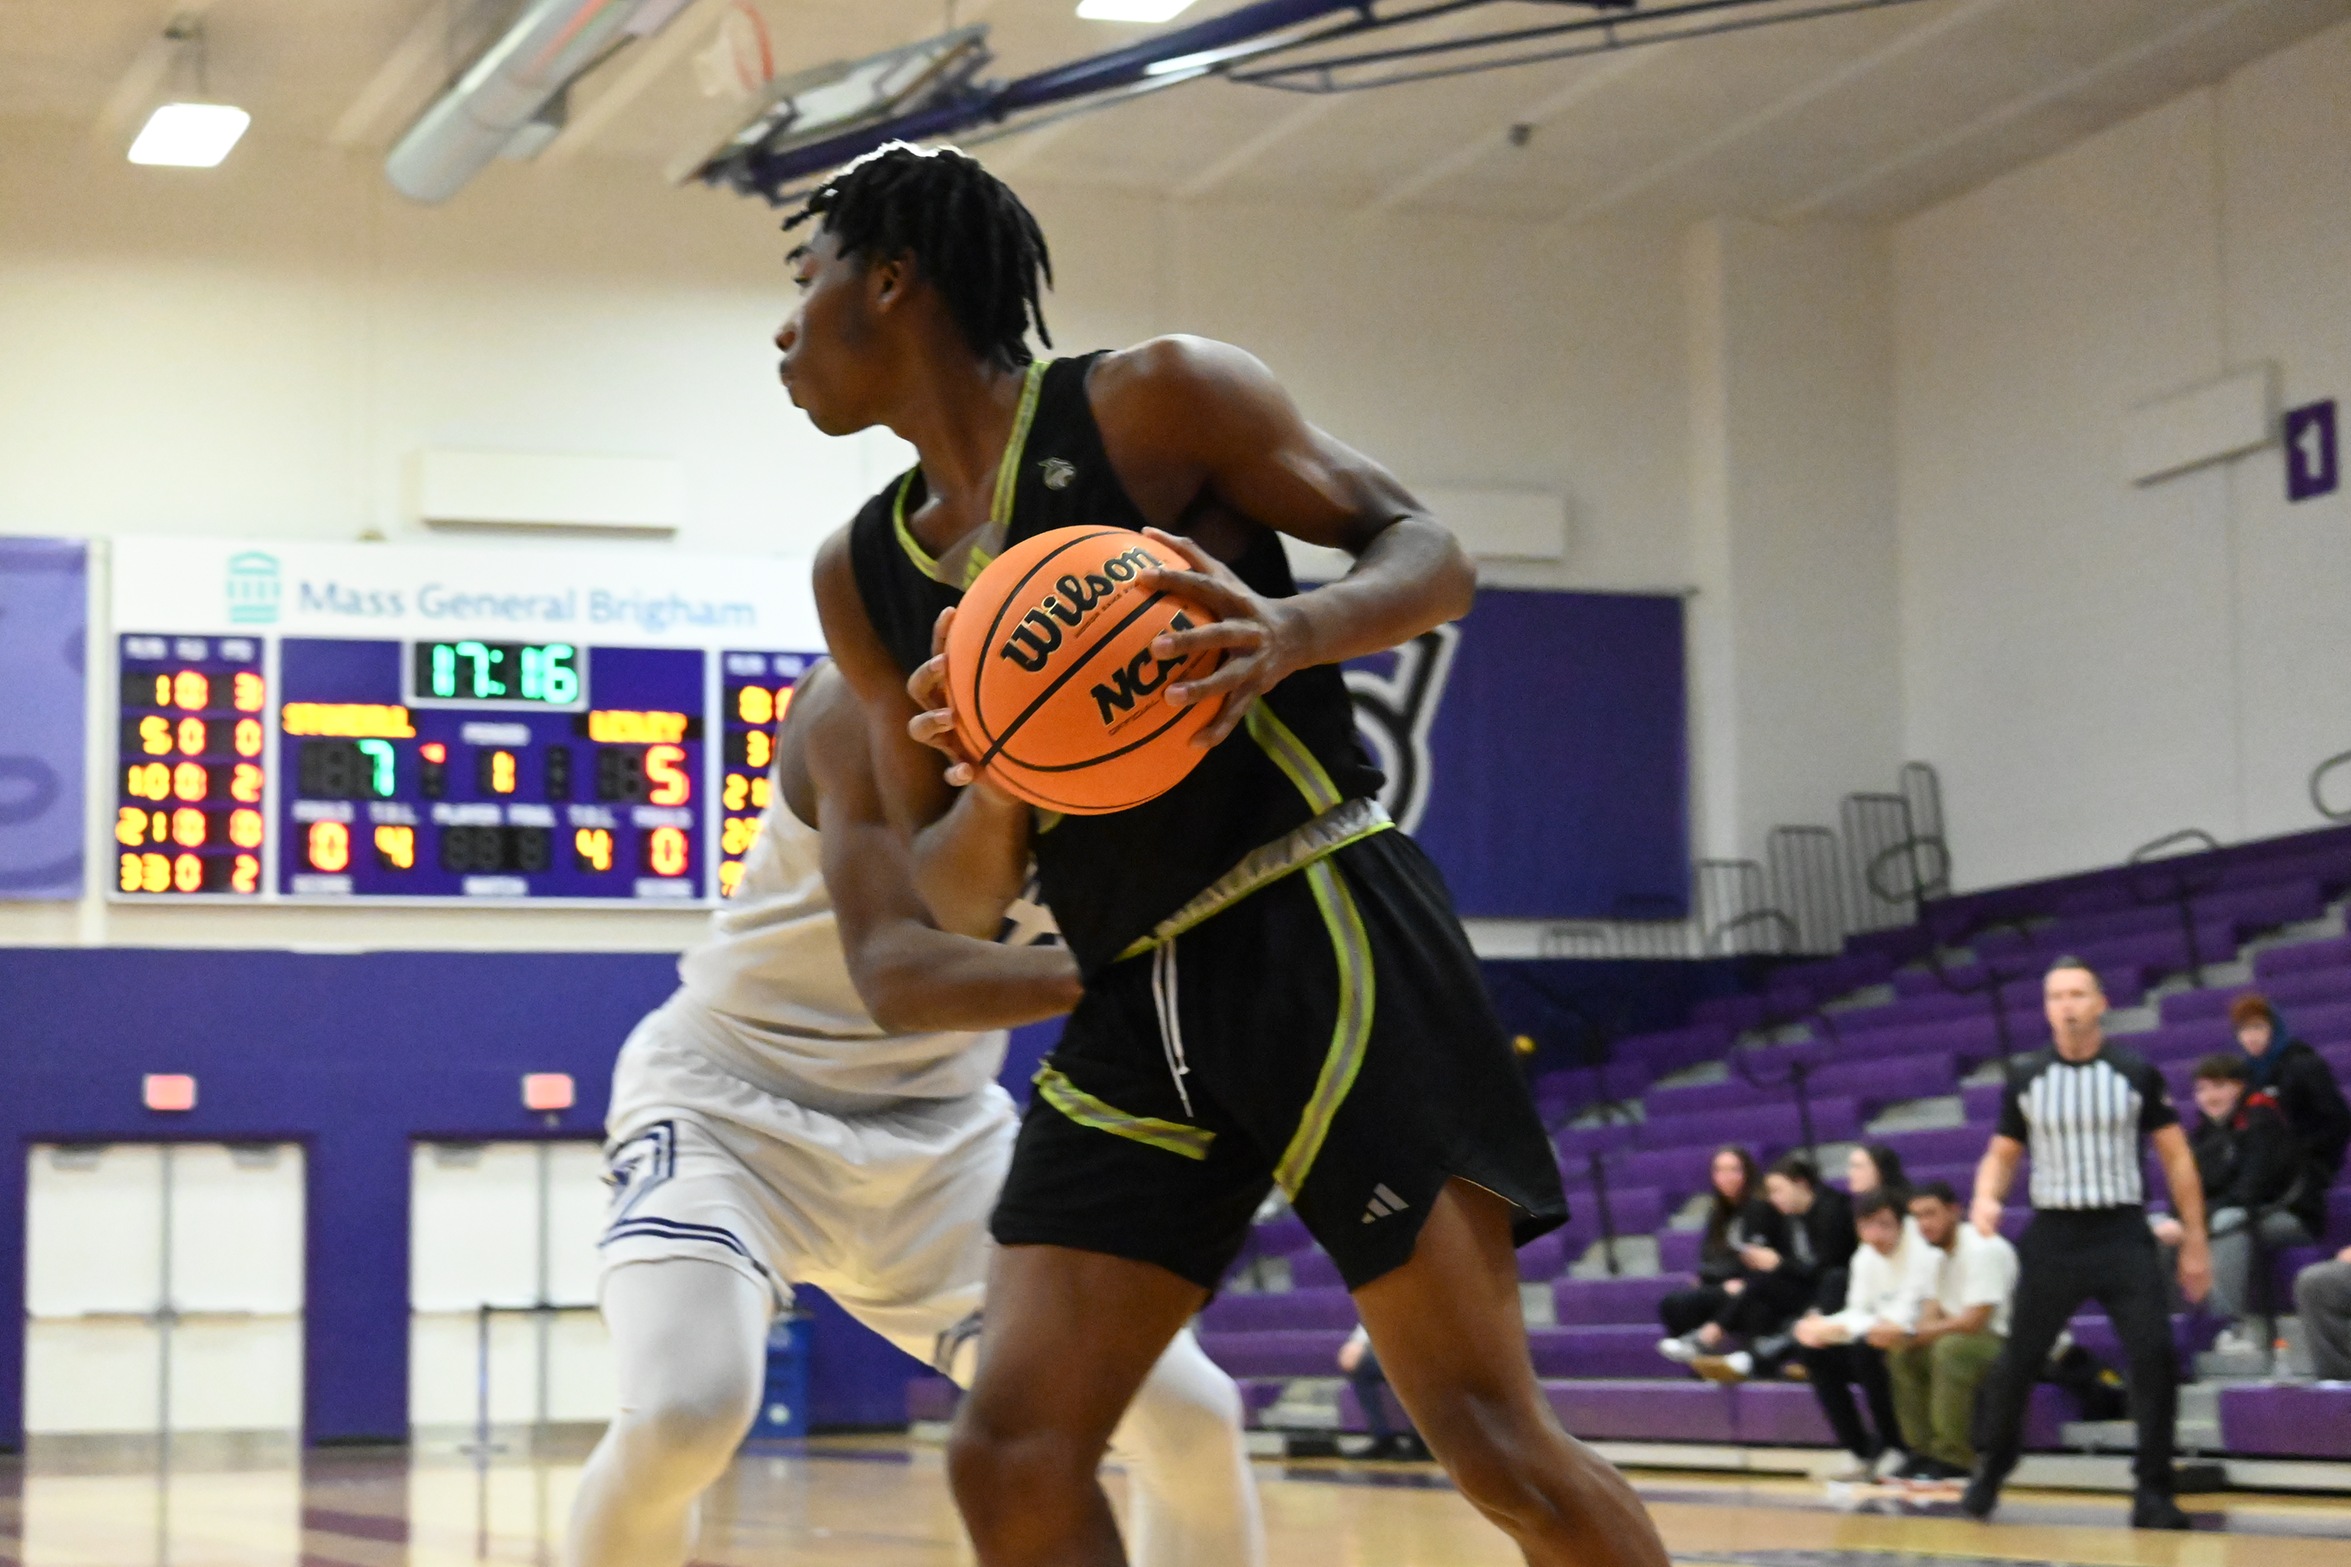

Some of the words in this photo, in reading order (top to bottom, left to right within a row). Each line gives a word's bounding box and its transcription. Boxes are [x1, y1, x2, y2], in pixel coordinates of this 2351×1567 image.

[2296, 419, 2323, 480] 1
[300, 582, 404, 616] Mass
[416, 583, 576, 622] General
[588, 589, 755, 633] Brigham
[1000, 546, 1166, 673] Wilson
[432, 640, 578, 704] 17:16
[358, 739, 395, 797] 7
[645, 743, 691, 807] 5
[308, 818, 350, 872] 0
[575, 828, 612, 871] 4
[651, 824, 689, 877] 0
